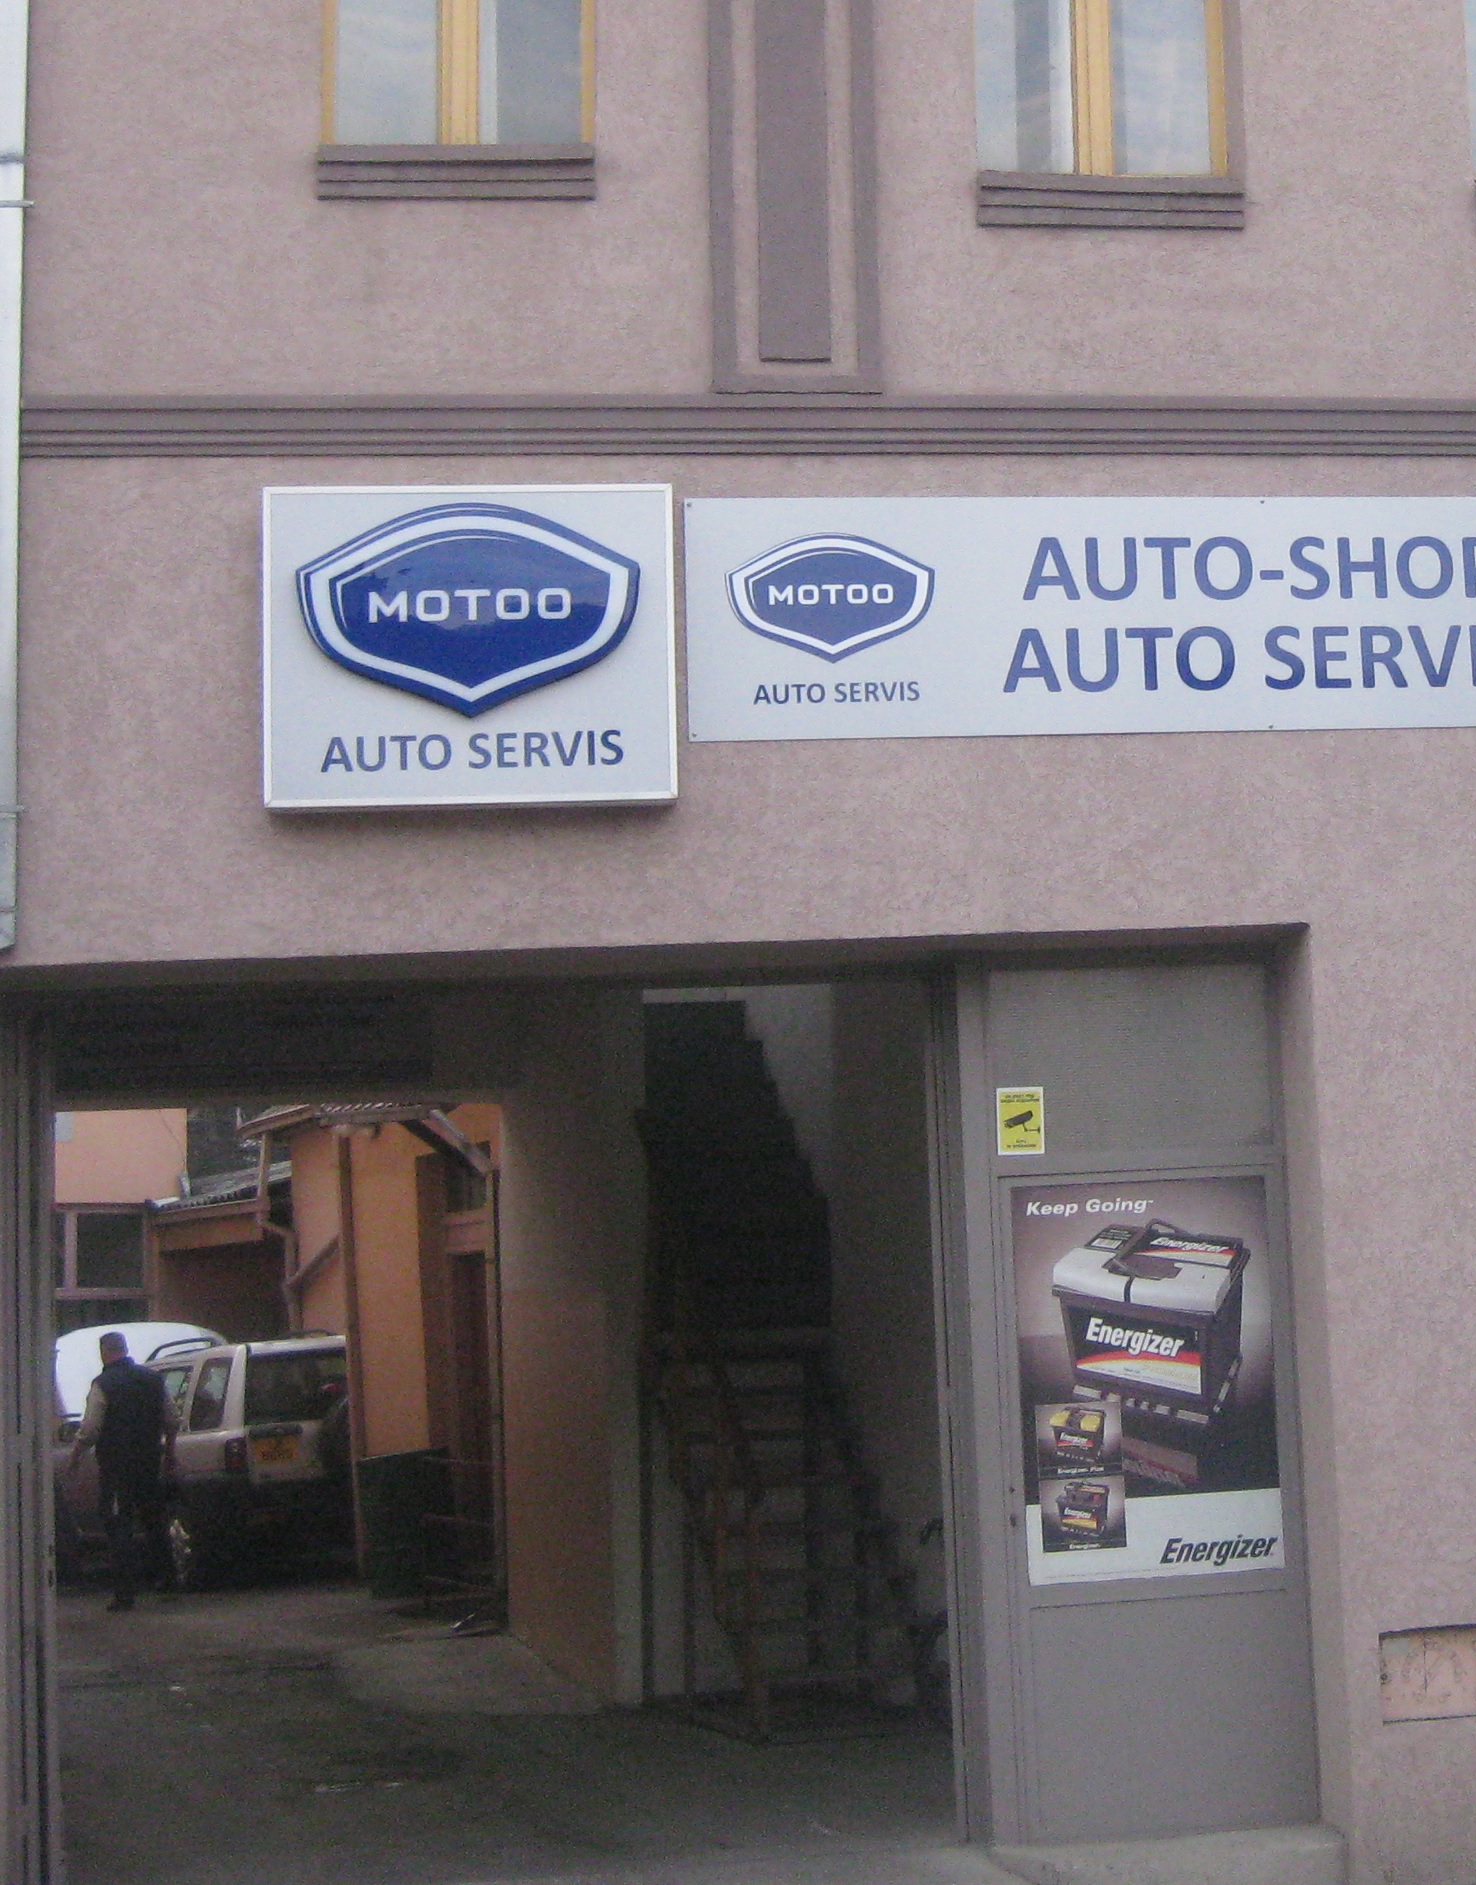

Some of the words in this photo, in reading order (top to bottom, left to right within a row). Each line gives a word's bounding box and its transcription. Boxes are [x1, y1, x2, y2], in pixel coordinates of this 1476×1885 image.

[367, 588, 573, 624] MOTOO
[767, 583, 894, 606] MOTOO
[1003, 626, 1237, 694] AUTO
[753, 684, 826, 706] AUTO
[833, 680, 921, 704] SERVIS
[320, 733, 454, 774] AUTO
[467, 728, 625, 770] SERVIS
[1026, 1201, 1079, 1217] Keep
[1150, 1236, 1230, 1254] Energizer
[1085, 1317, 1185, 1357] Energizer
[1160, 1535, 1278, 1566] Energizer
